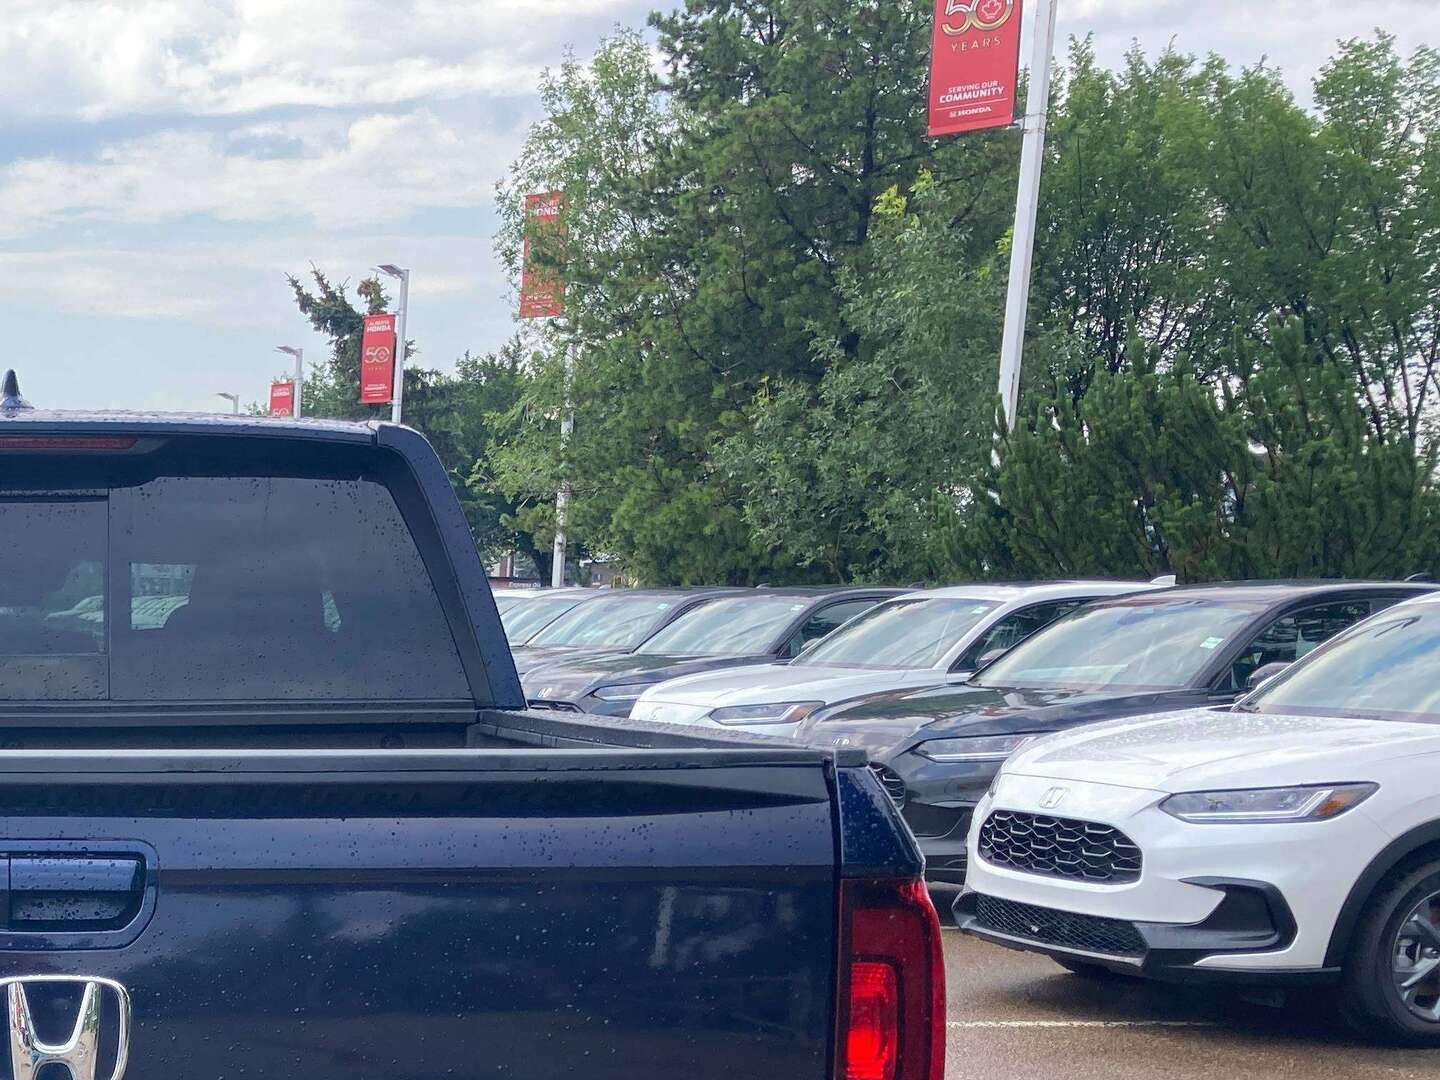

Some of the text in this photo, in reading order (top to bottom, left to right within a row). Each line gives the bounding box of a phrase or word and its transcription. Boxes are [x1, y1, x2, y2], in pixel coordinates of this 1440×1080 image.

[951, 37, 1001, 52] YEARS
[948, 80, 998, 94] SERVING OUR
[939, 86, 1004, 104] COMMUNITY
[958, 106, 992, 117] HONDA
[364, 346, 390, 364] 50
